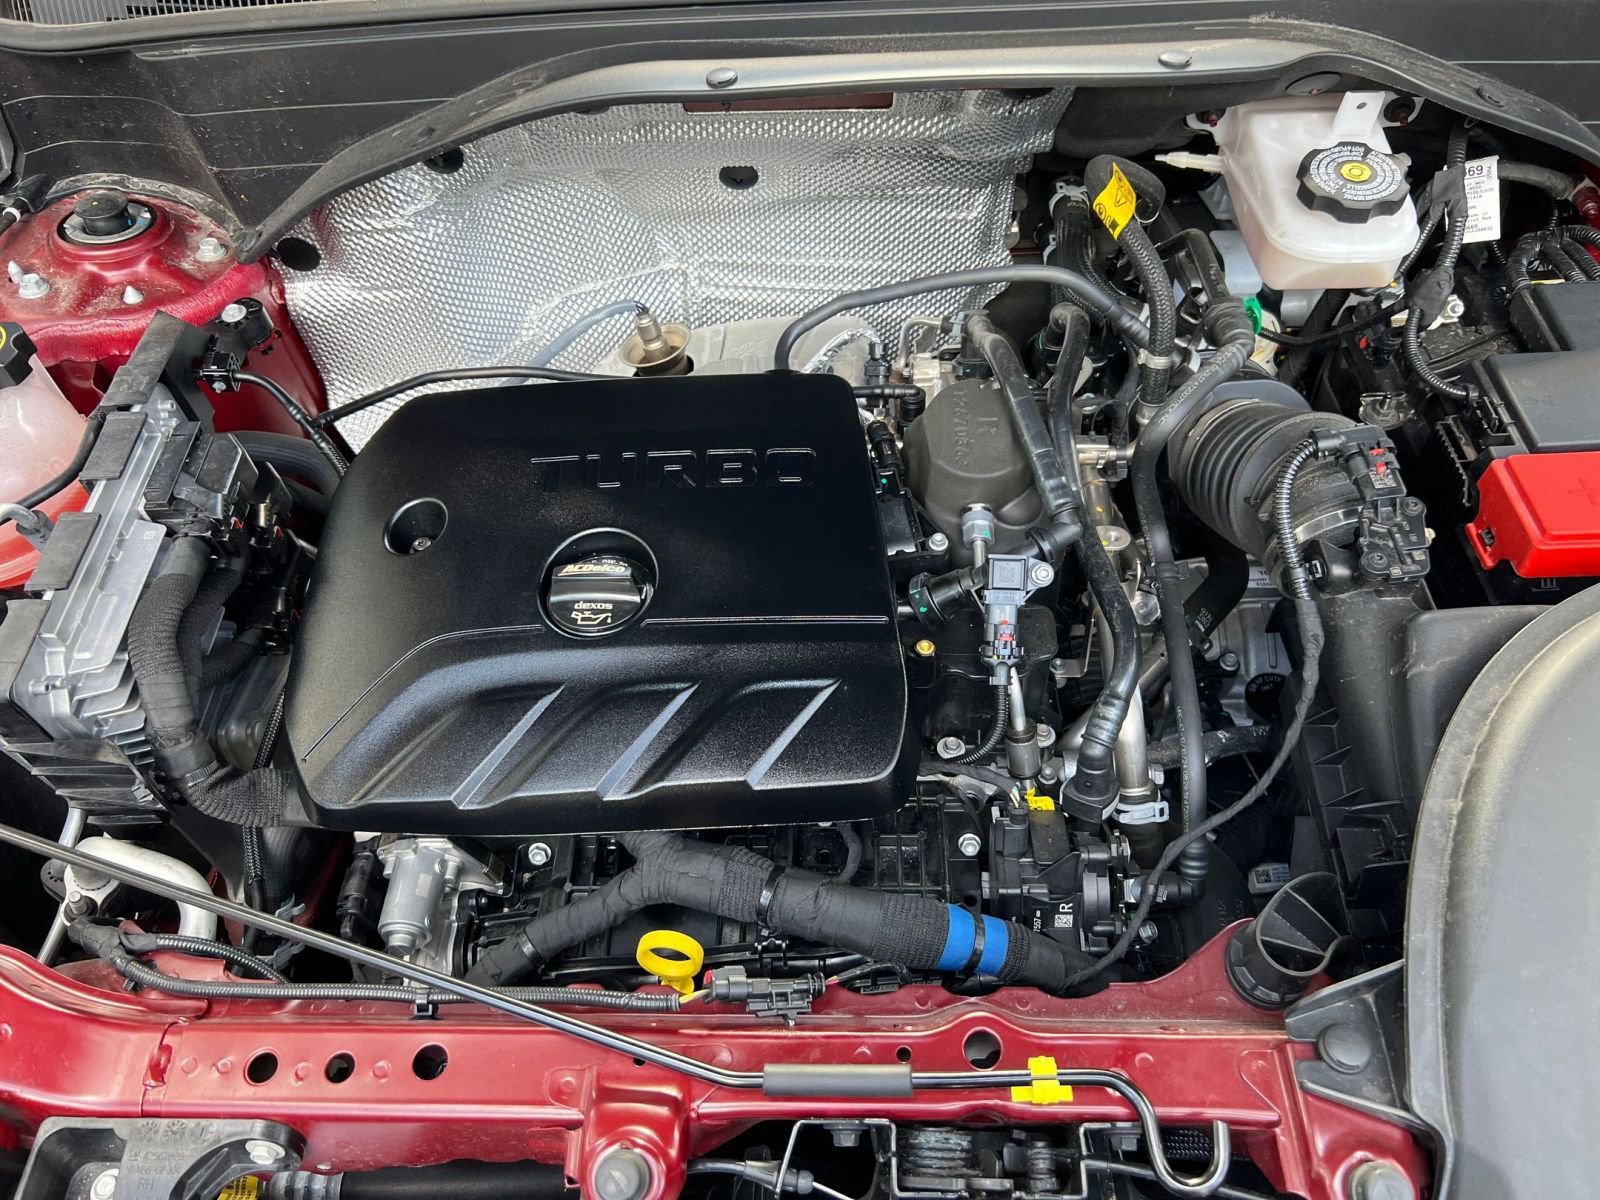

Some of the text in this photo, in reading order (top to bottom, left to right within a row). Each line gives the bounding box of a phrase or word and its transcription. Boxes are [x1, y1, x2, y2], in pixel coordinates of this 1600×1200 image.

[1465, 164, 1484, 177] 69
[530, 447, 817, 493] TURBO
[560, 563, 626, 573] ACDelco
[574, 601, 613, 610] dexos
[1060, 903, 1073, 912] R
